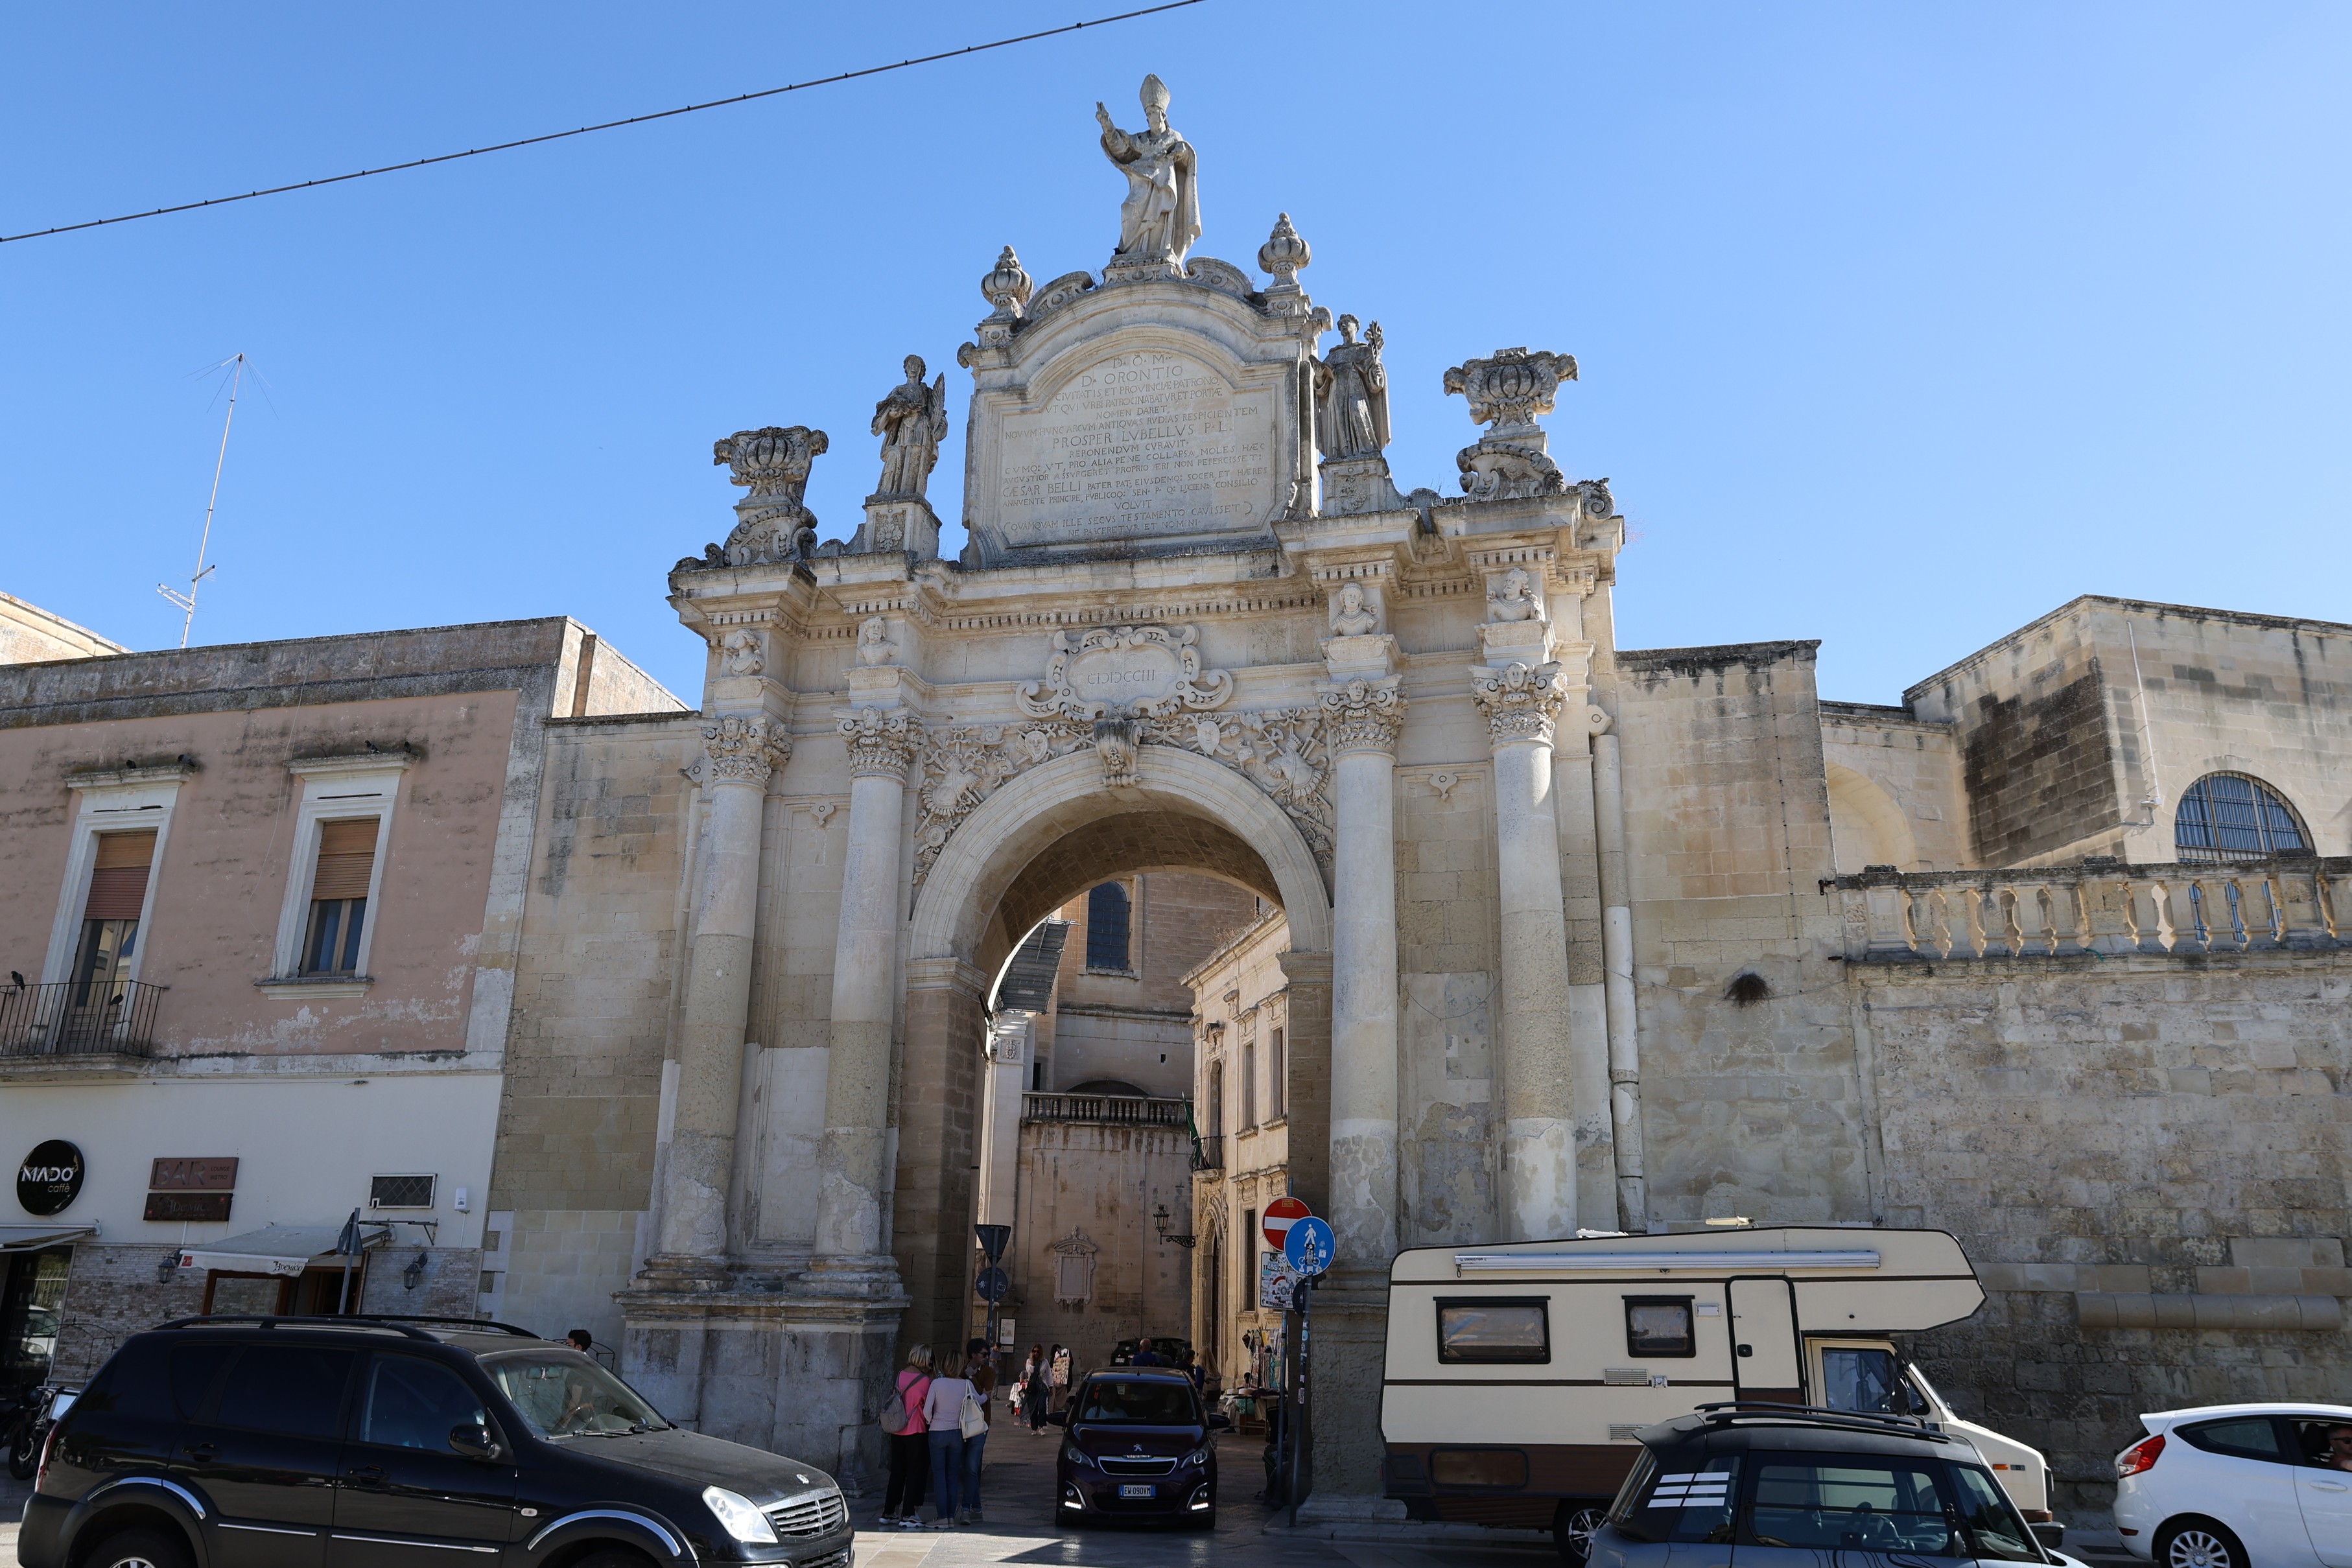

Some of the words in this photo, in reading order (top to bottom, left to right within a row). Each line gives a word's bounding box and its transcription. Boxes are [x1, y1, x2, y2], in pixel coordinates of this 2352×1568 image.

[1104, 366, 1183, 384] ORONTIO
[1105, 388, 1116, 397] ET
[1182, 406, 1258, 421] RESPICIENTEM
[1053, 432, 1112, 449] PROSPER
[1122, 424, 1195, 442] LVBELLVS
[1069, 444, 1139, 458] REPONENDVM
[1069, 460, 1086, 469] PRO
[1201, 445, 1235, 456] MOLES
[1116, 465, 1149, 474] PROPRIO
[1002, 497, 1045, 507] ANNVENTE
[1216, 478, 1258, 489] CONSILIO
[1048, 481, 1081, 494] BELLI
[1087, 482, 1112, 491] PATER
[1114, 499, 1153, 510] VOLVIT
[1063, 518, 1083, 528] ILLE
[1088, 515, 1116, 525] SECVS
[1068, 529, 1079, 537] NE
[21, 1166, 74, 1182] MADO
[152, 1161, 207, 1186] BAR
[47, 1183, 70, 1193] caffè
